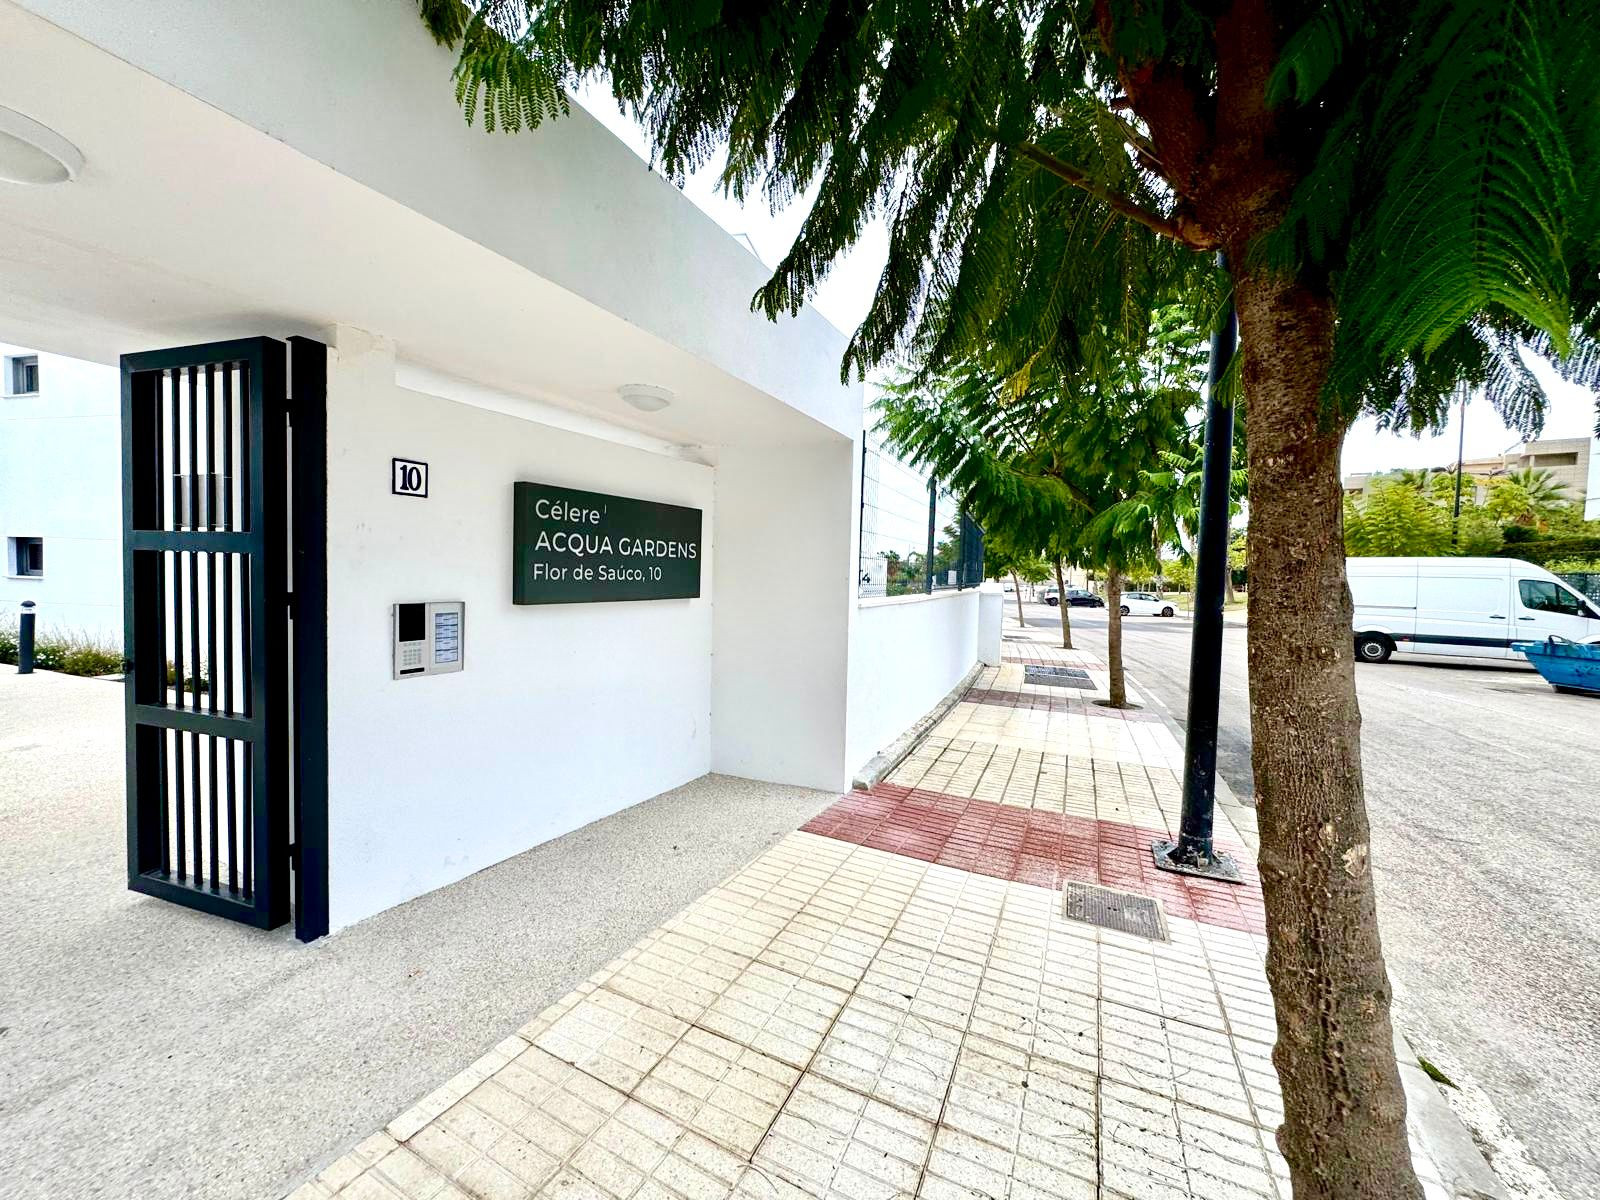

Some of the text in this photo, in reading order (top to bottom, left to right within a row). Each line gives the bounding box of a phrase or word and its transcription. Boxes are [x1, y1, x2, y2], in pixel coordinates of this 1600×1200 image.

[400, 464, 422, 491] 10
[535, 499, 600, 524] Célere
[534, 530, 697, 559] ACQUA GARDENS
[533, 562, 662, 582] Flor de Saúco, 10
